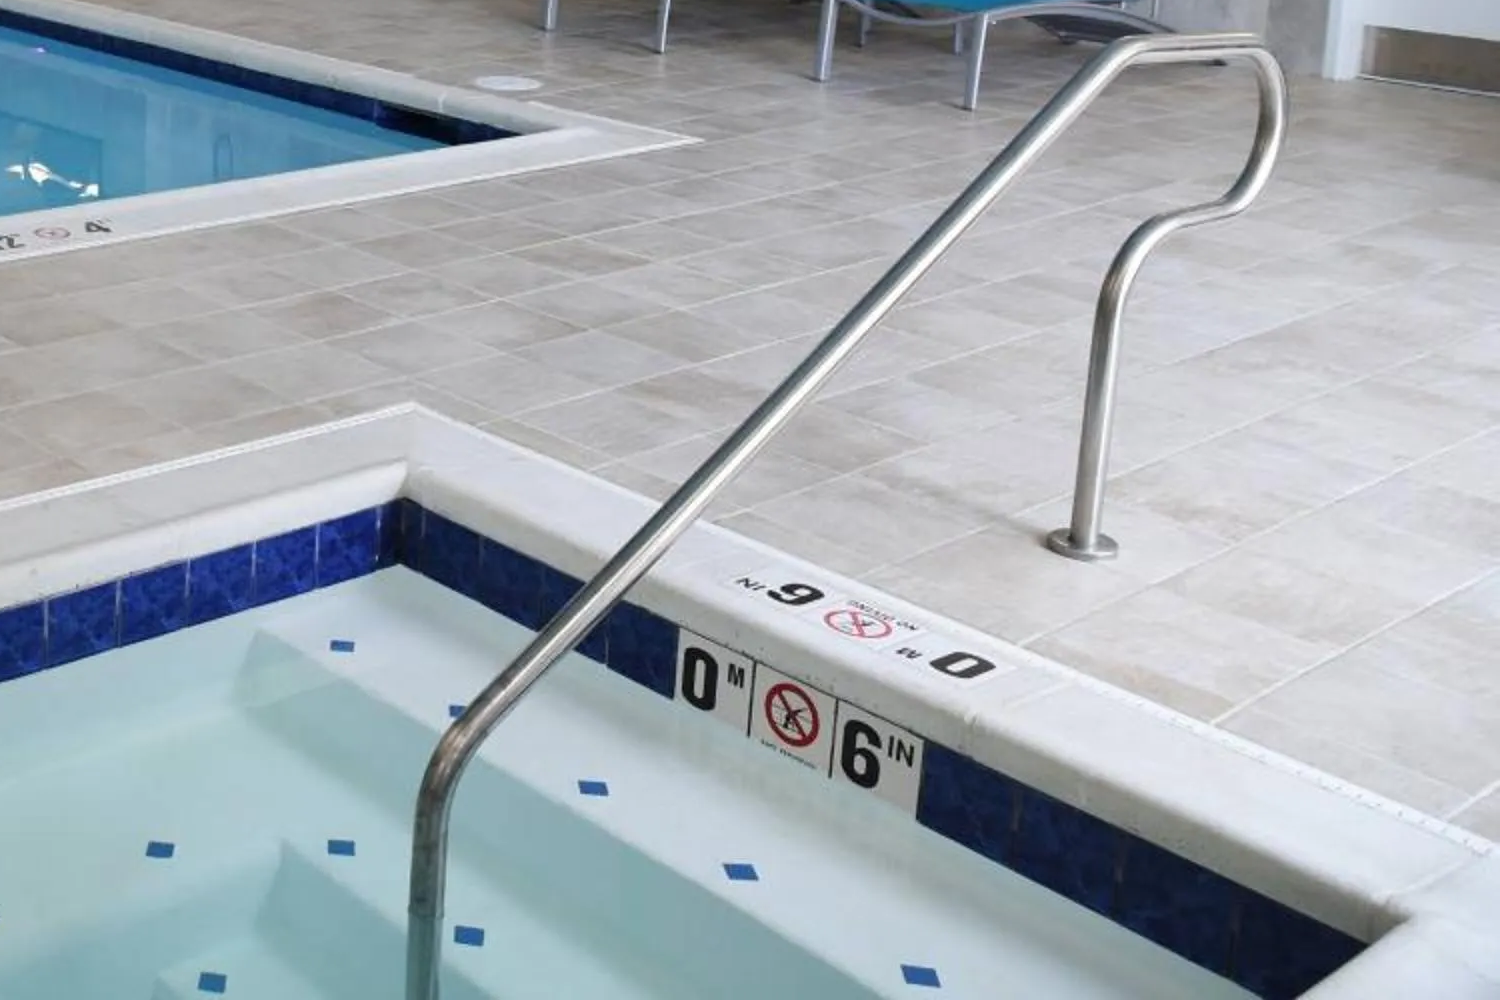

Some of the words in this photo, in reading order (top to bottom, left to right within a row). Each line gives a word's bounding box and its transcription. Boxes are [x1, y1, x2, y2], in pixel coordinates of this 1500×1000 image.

[767, 583, 825, 606] 6
[929, 651, 997, 679] 0
[681, 646, 718, 711] 0
[727, 663, 745, 689] M
[841, 719, 883, 789] 6
[888, 735, 915, 768] IN
